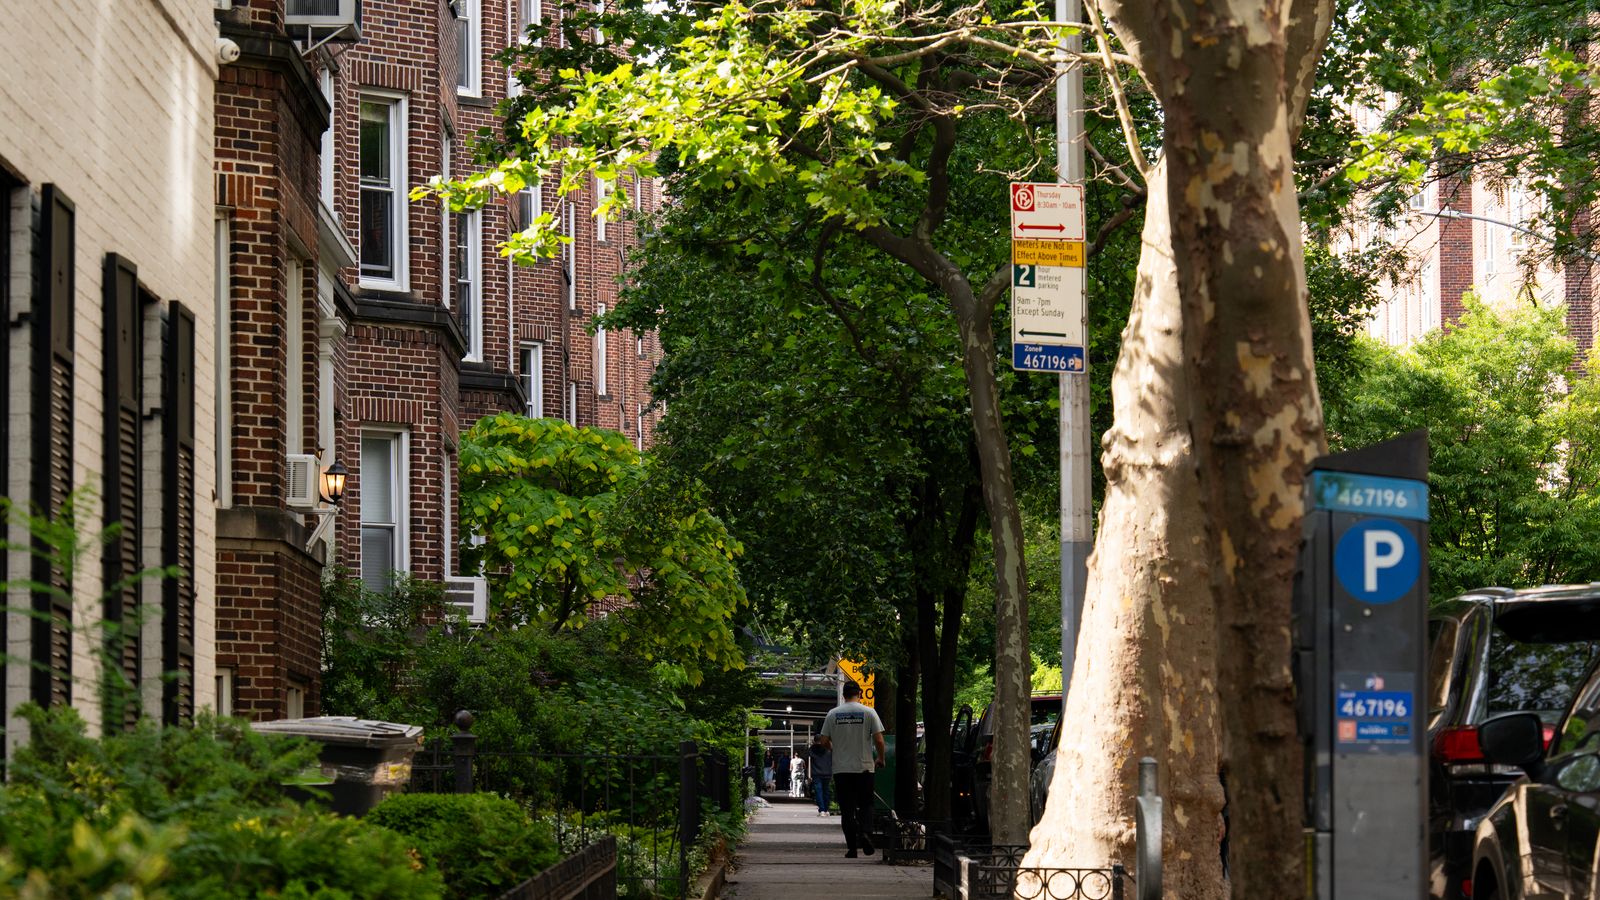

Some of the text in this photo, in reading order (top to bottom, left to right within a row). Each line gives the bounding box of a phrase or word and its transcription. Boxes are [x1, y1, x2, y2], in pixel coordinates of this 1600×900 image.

[1016, 241, 1039, 249] Meters
[1040, 241, 1052, 249] Are
[1053, 242, 1065, 250] Not
[1017, 251, 1078, 262] Effect Above Times
[1018, 265, 1031, 285] 2
[1038, 282, 1059, 290] parking
[1016, 296, 1031, 305] 9am
[1037, 297, 1051, 307] 7pm
[1016, 306, 1065, 318] Except Sunday
[1023, 354, 1067, 369] 467196
[1338, 488, 1408, 508] 467196
[1363, 529, 1405, 592] P
[1341, 698, 1407, 717] 467196
